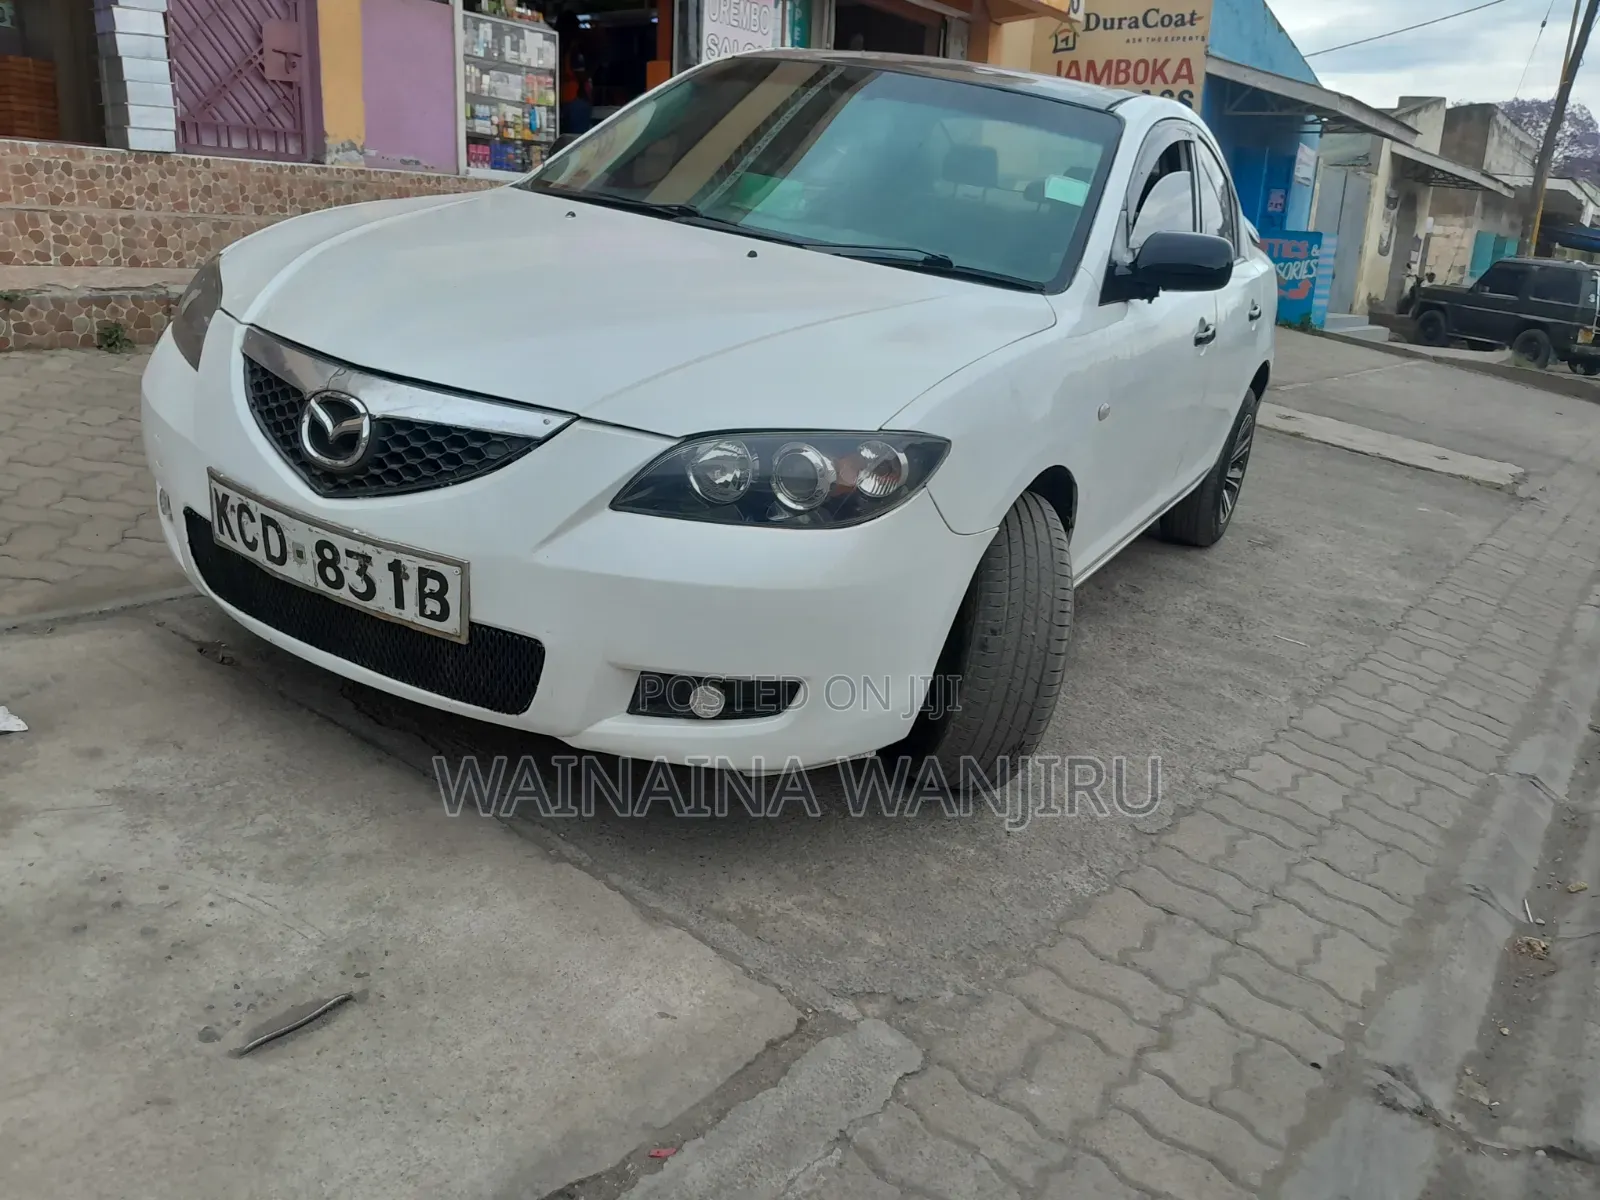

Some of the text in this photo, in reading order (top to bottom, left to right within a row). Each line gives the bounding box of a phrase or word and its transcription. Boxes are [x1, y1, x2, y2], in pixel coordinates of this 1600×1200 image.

[1083, 8, 1198, 32] DuraCoat
[213, 487, 450, 623] KCD 831B
